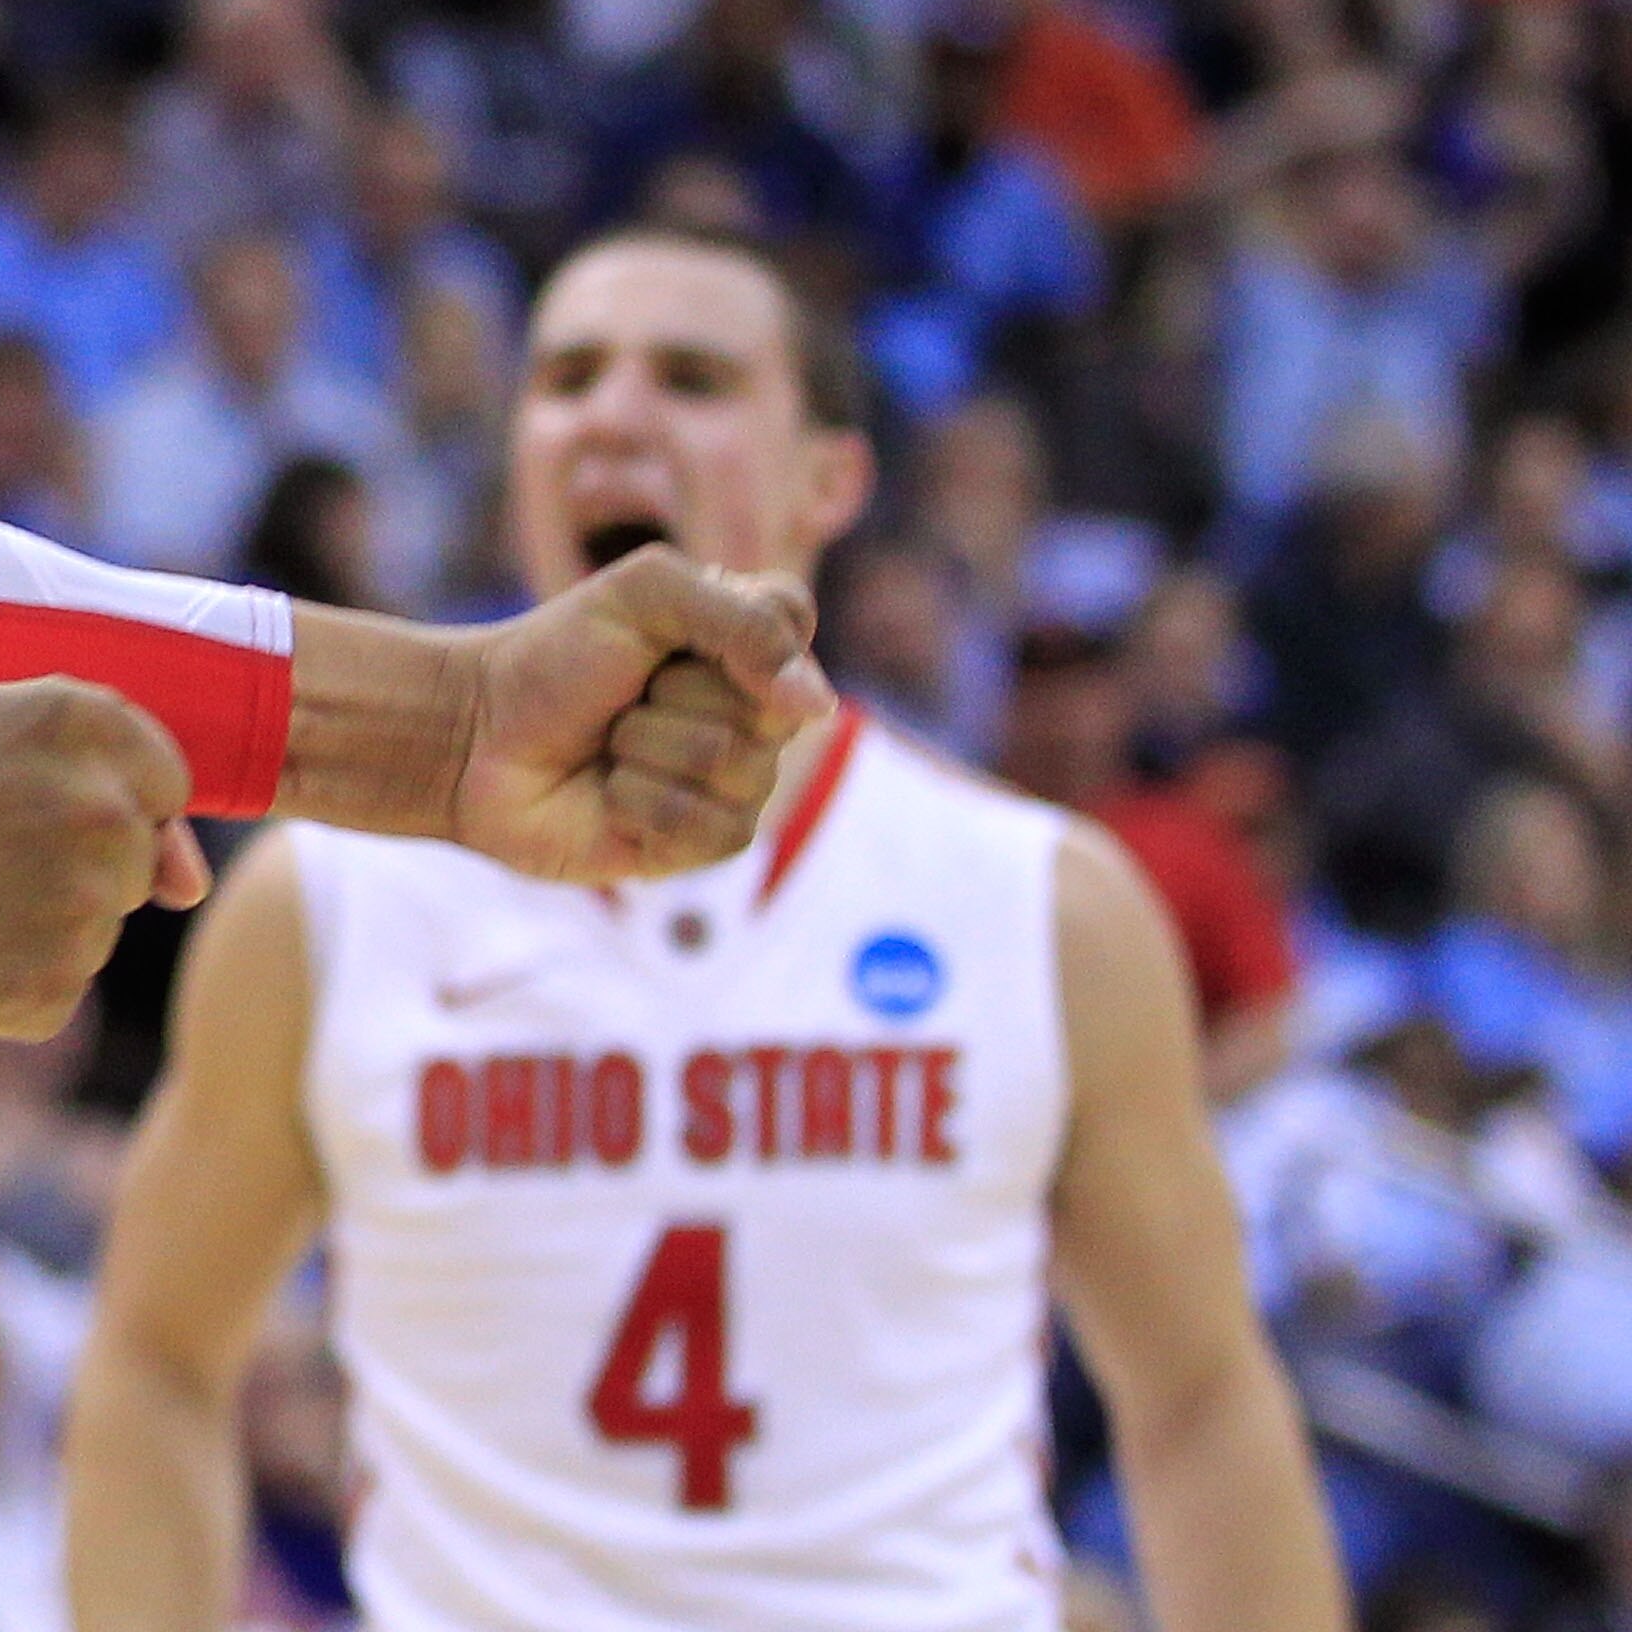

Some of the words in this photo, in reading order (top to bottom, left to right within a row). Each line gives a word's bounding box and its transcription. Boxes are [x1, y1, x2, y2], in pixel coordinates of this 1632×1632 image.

[416, 1050, 646, 1176] OHIO
[679, 1044, 960, 1166] STATE
[586, 1223, 758, 1513] 4
